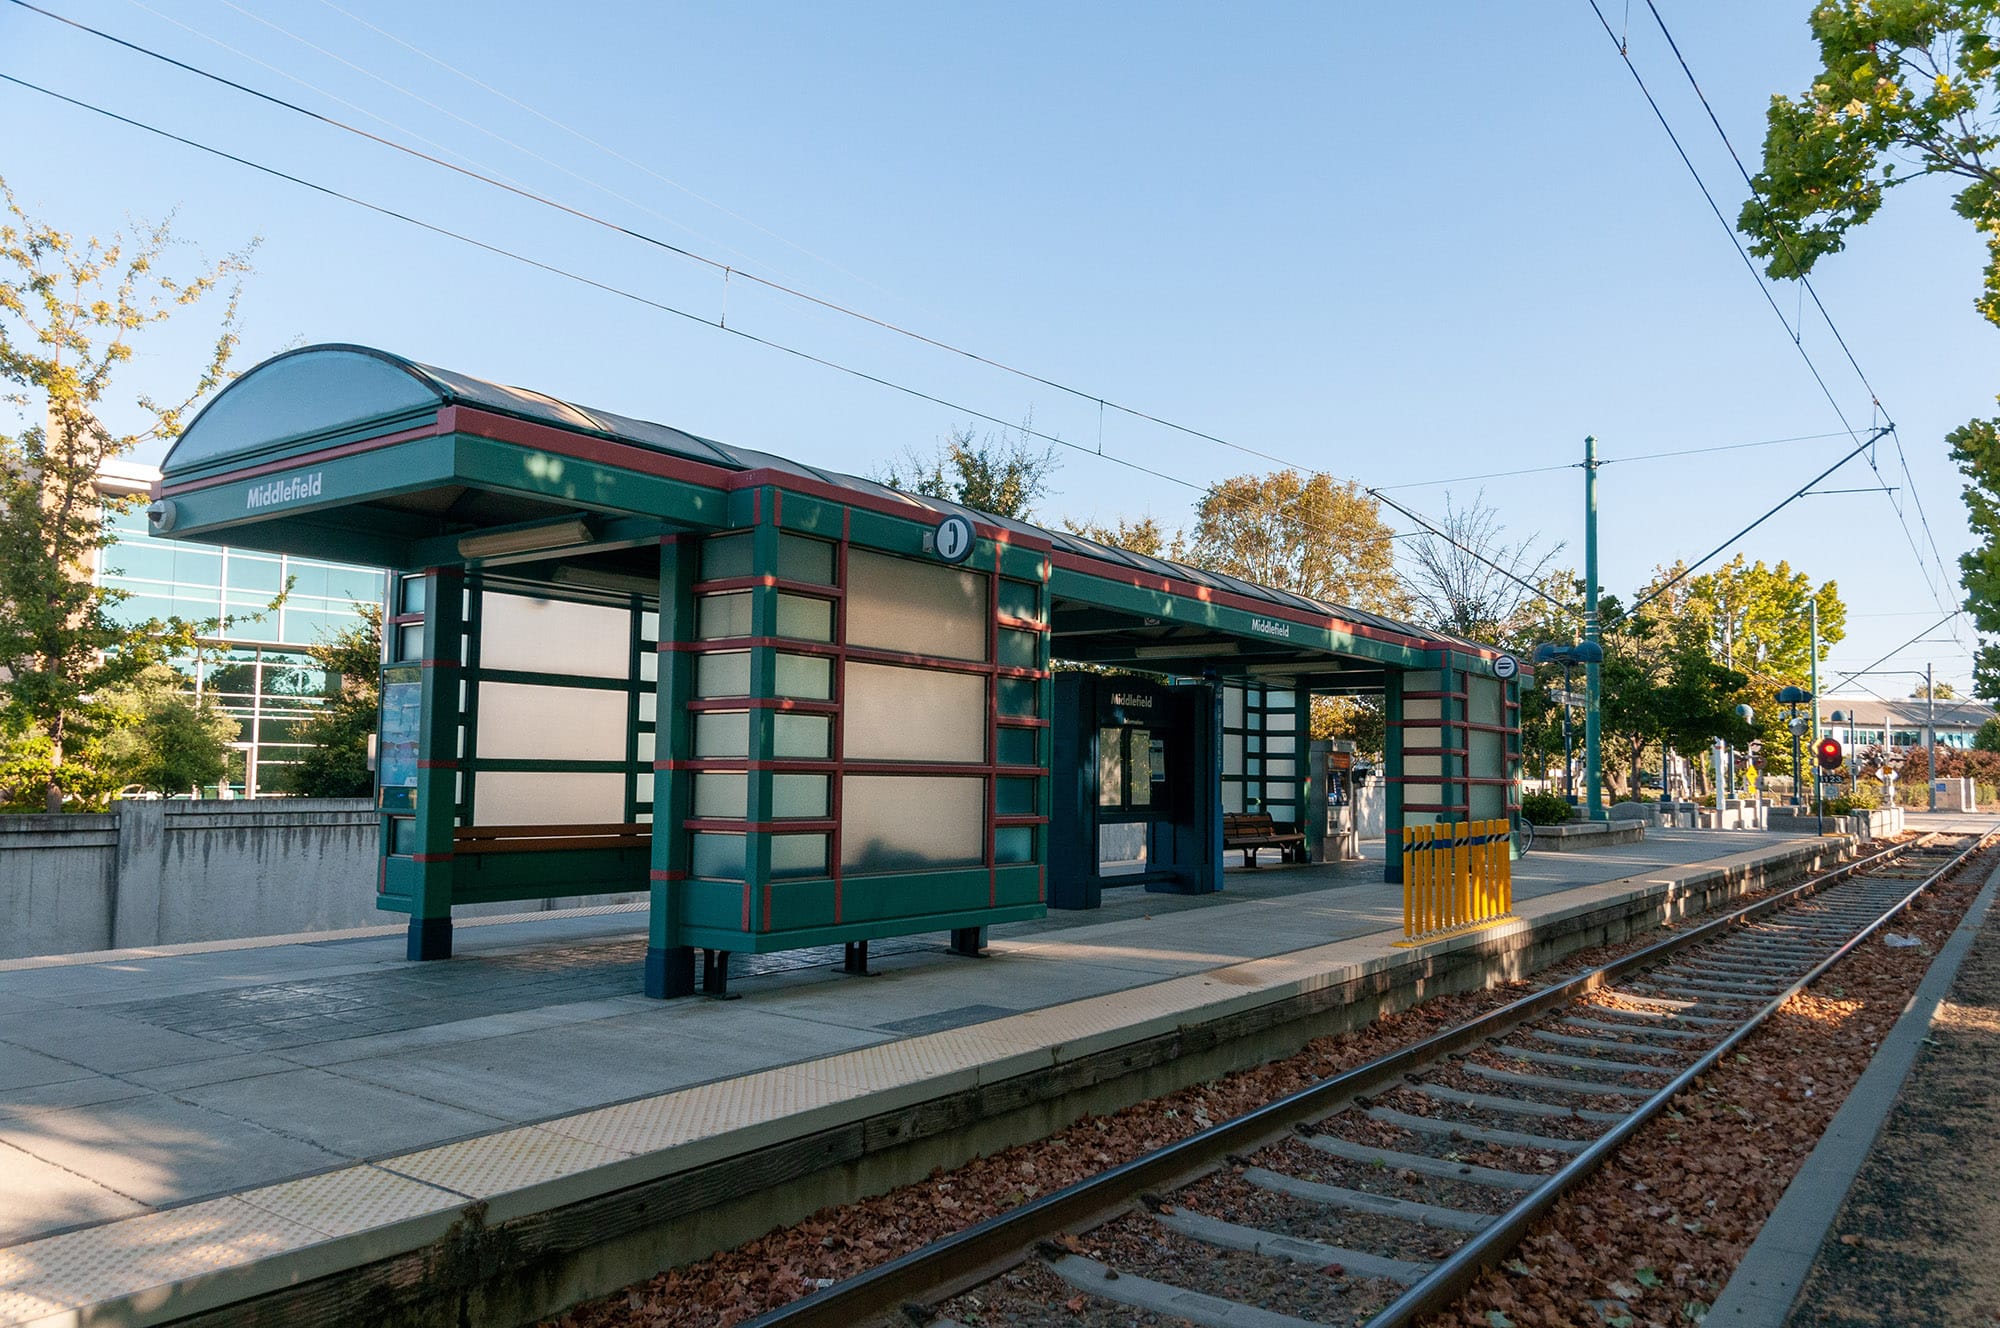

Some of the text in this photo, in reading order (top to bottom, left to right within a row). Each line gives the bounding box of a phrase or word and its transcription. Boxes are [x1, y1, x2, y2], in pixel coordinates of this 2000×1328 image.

[246, 472, 322, 509] Middlefield
[1251, 618, 1290, 638] Middlefield
[1110, 692, 1153, 708] Middlefield
